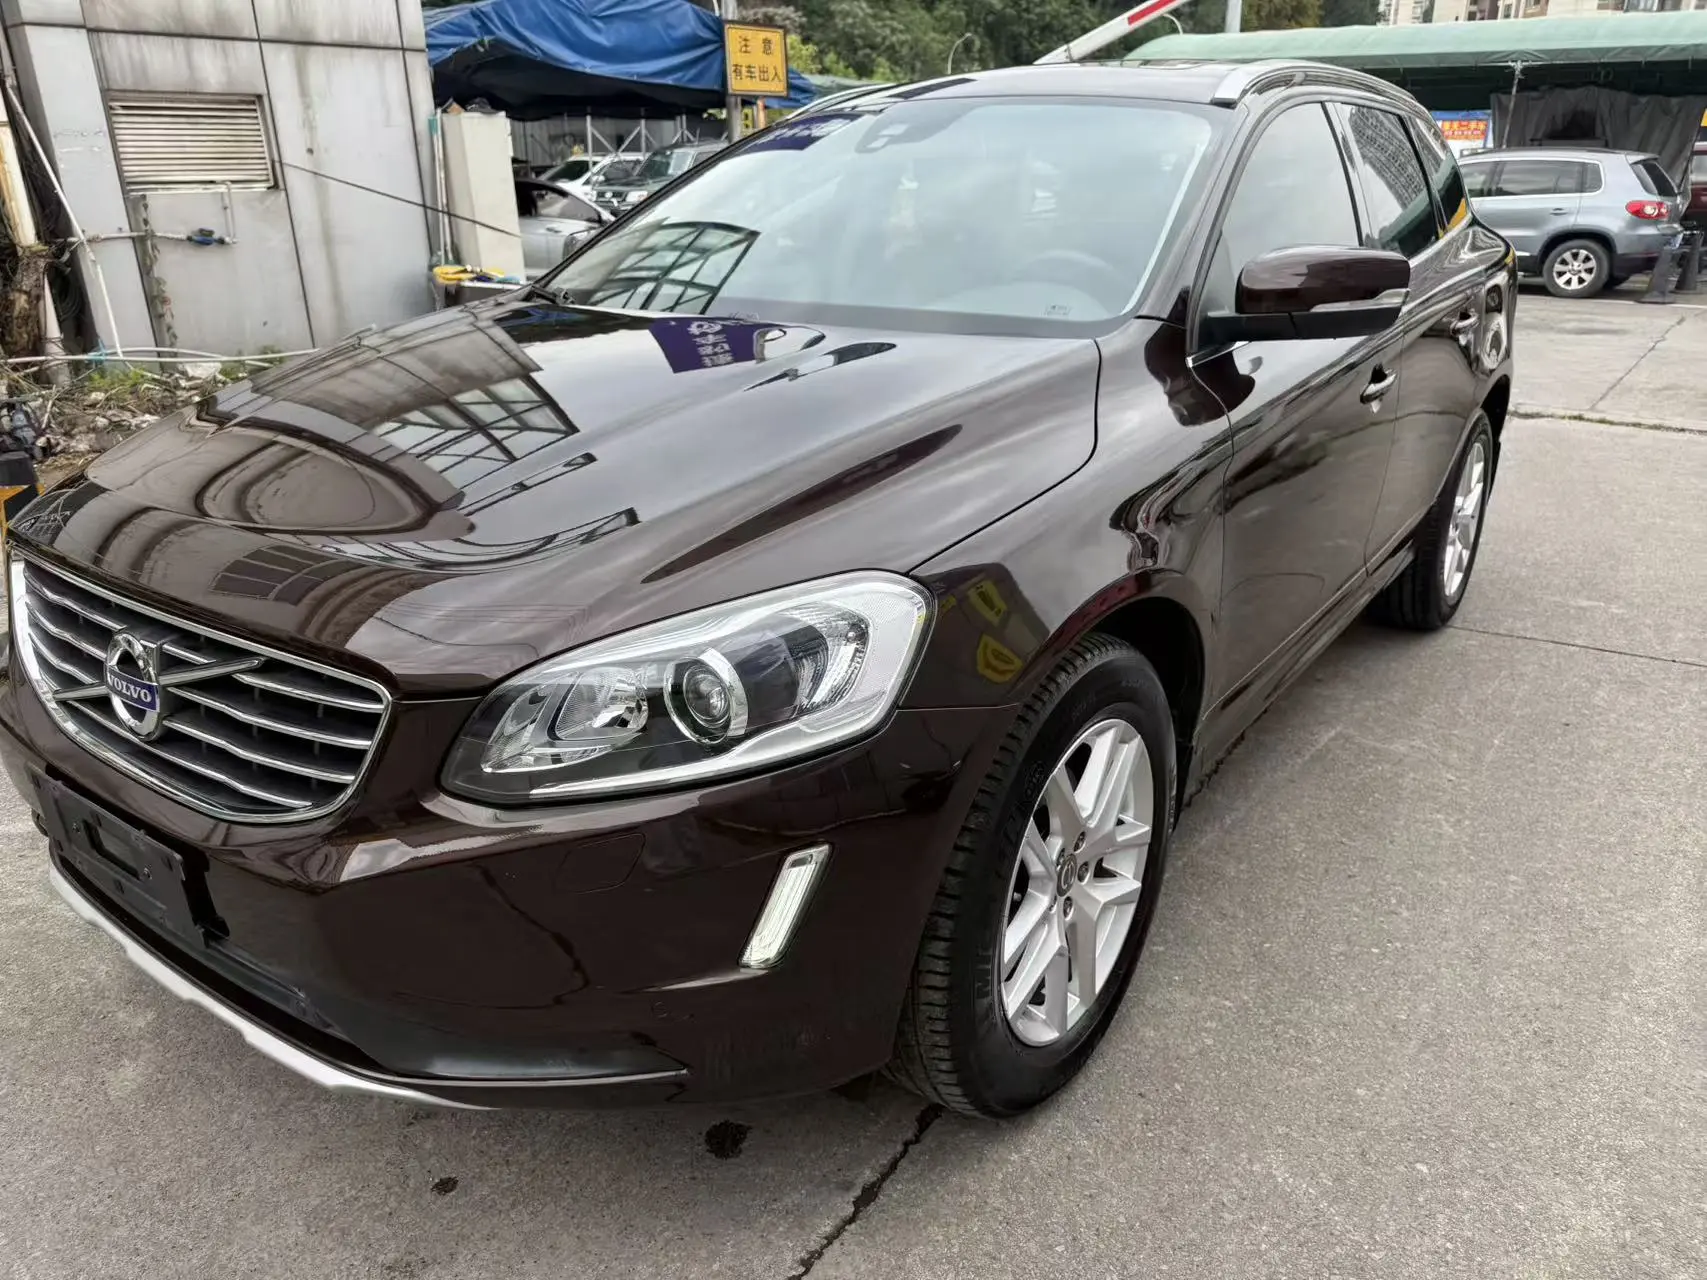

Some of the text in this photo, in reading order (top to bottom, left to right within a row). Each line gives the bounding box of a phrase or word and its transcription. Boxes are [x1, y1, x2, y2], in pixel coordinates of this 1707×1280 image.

[739, 35, 773, 55] 注意
[732, 63, 782, 82] 有车出入
[109, 674, 152, 703] VOLVO
